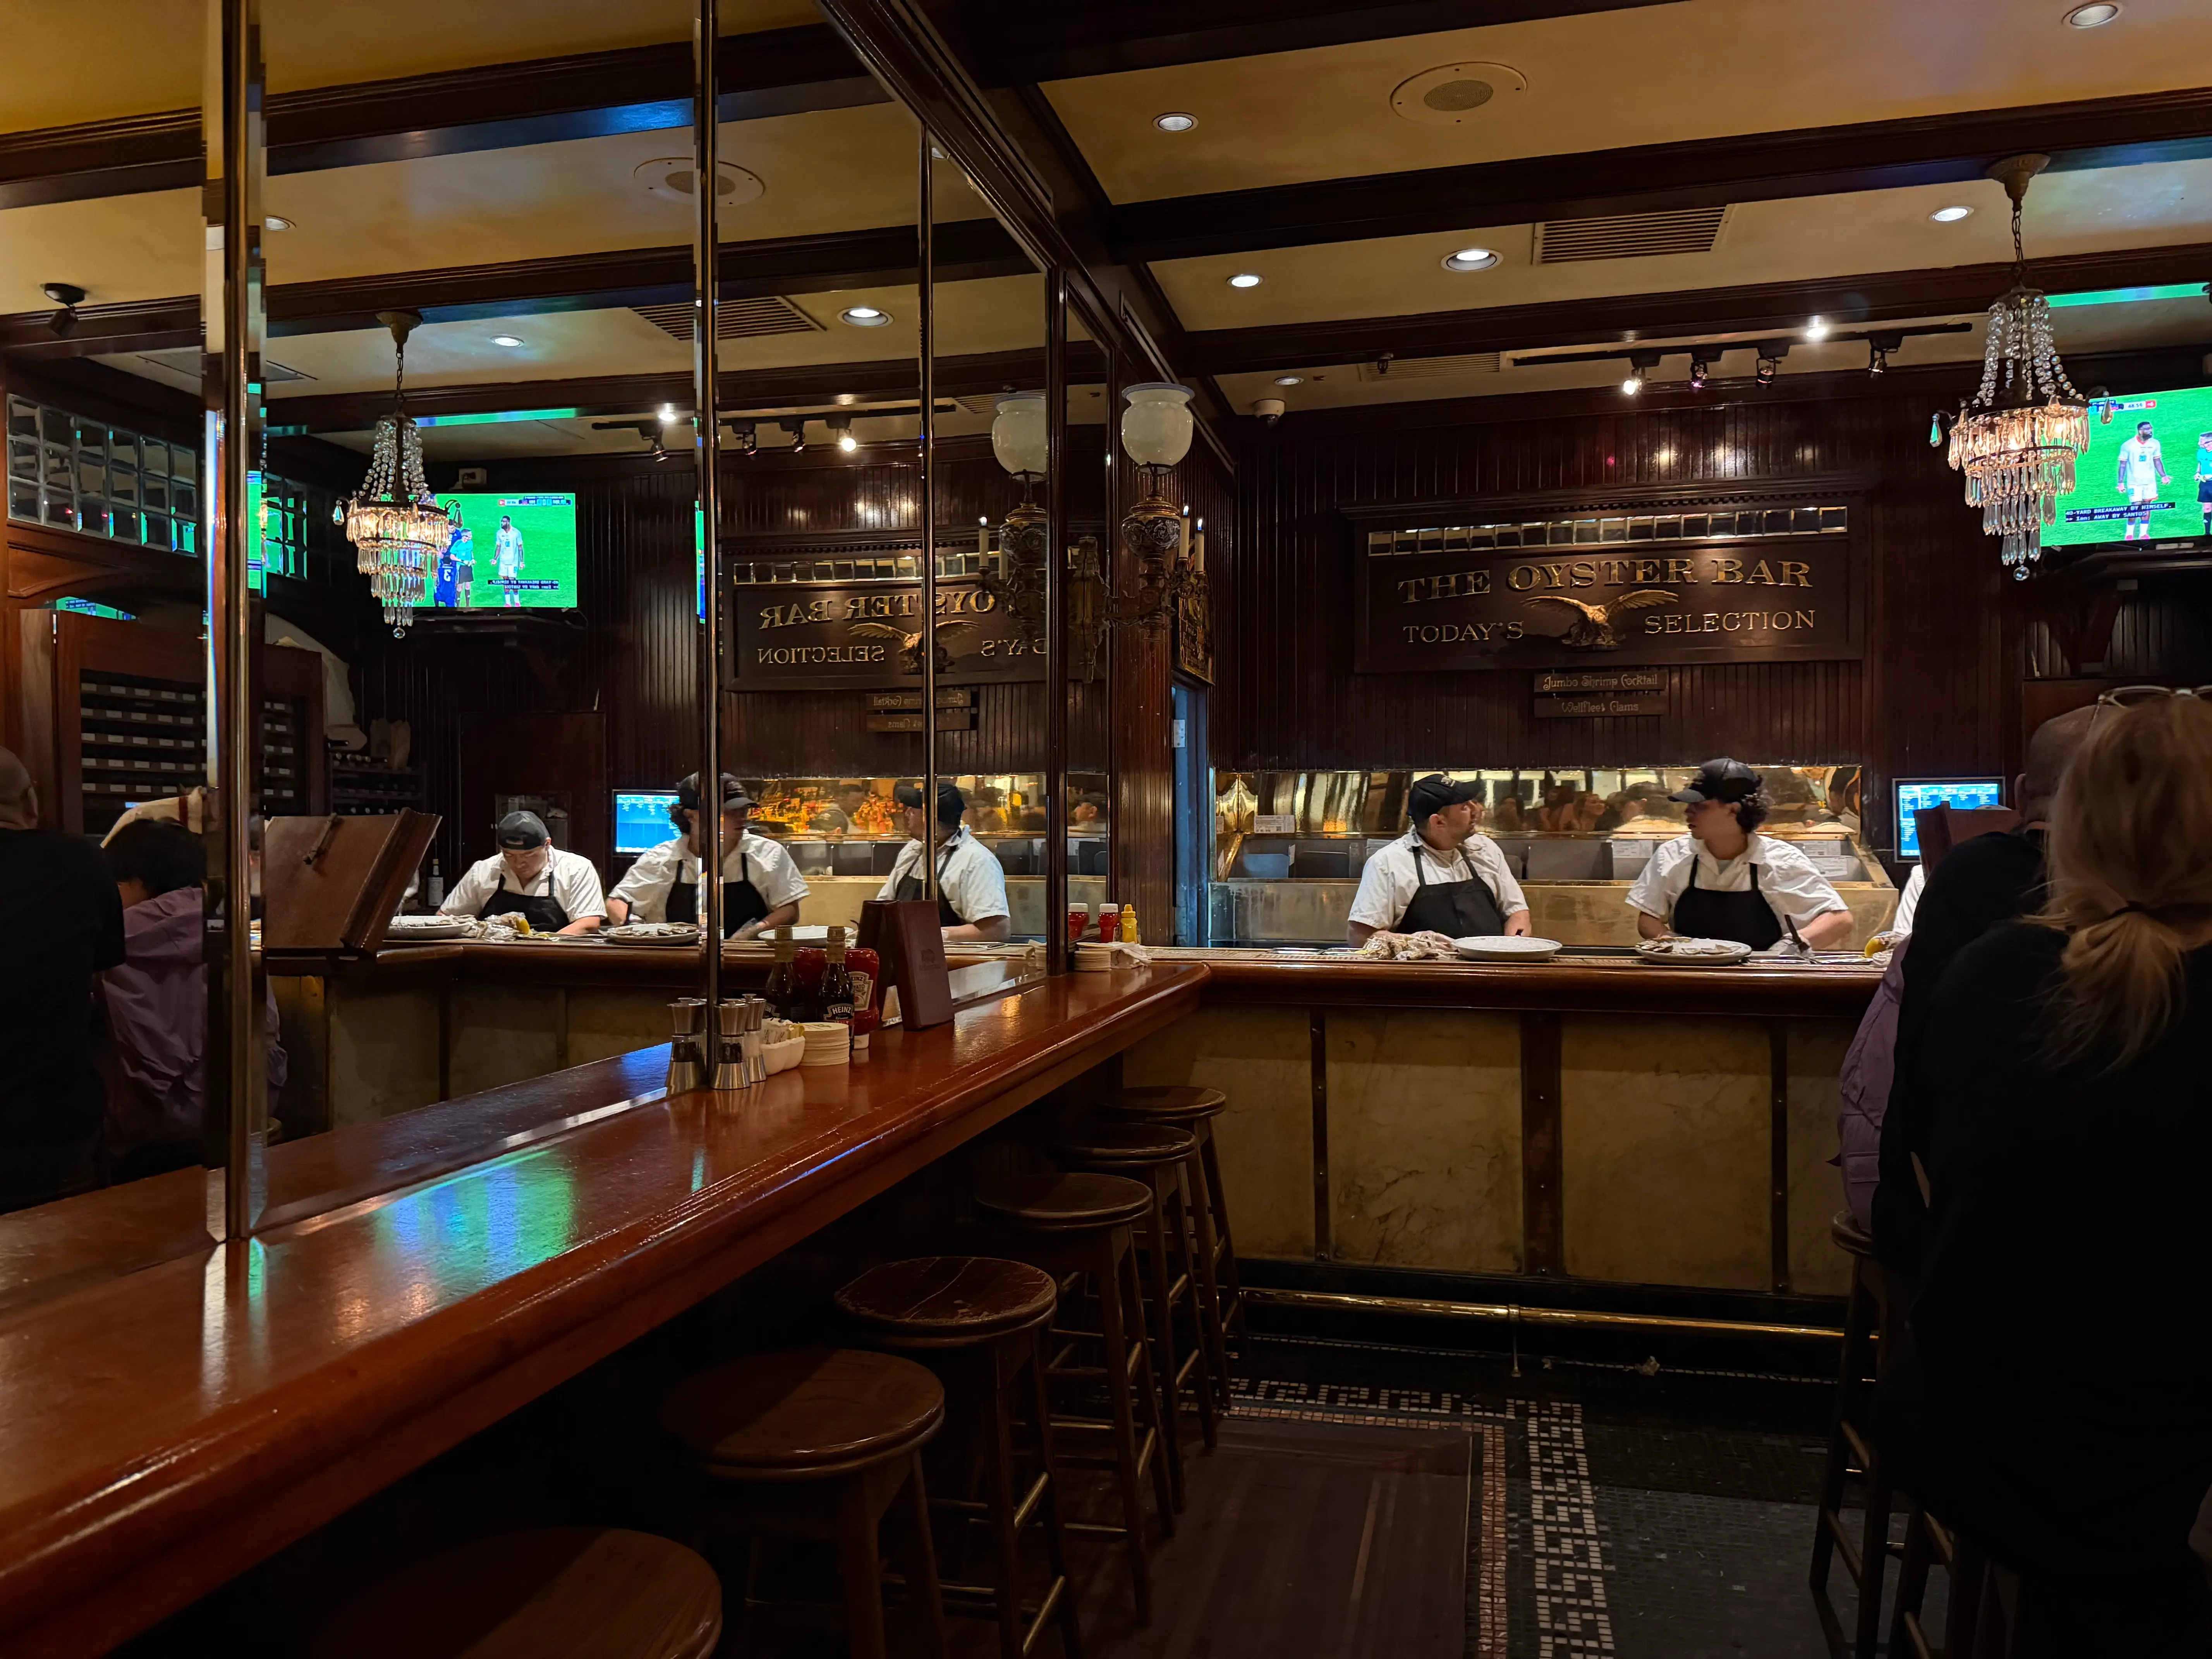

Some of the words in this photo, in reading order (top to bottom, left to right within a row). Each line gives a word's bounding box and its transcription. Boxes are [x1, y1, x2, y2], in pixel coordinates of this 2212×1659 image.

[1397, 570, 1491, 604] THE
[1506, 558, 1698, 591] OYSTER
[1711, 558, 1813, 587] BAR
[1403, 620, 1524, 643] TODAY'S
[1644, 610, 1815, 634] SELECTION
[1543, 676, 1578, 690] Jumbo
[1581, 675, 1618, 689] Shrimp
[1621, 673, 1657, 688] Cocktail
[1562, 702, 1606, 713] Wellfleet
[1609, 700, 1639, 712] Clams
[832, 1006, 851, 1014] HEINZ
